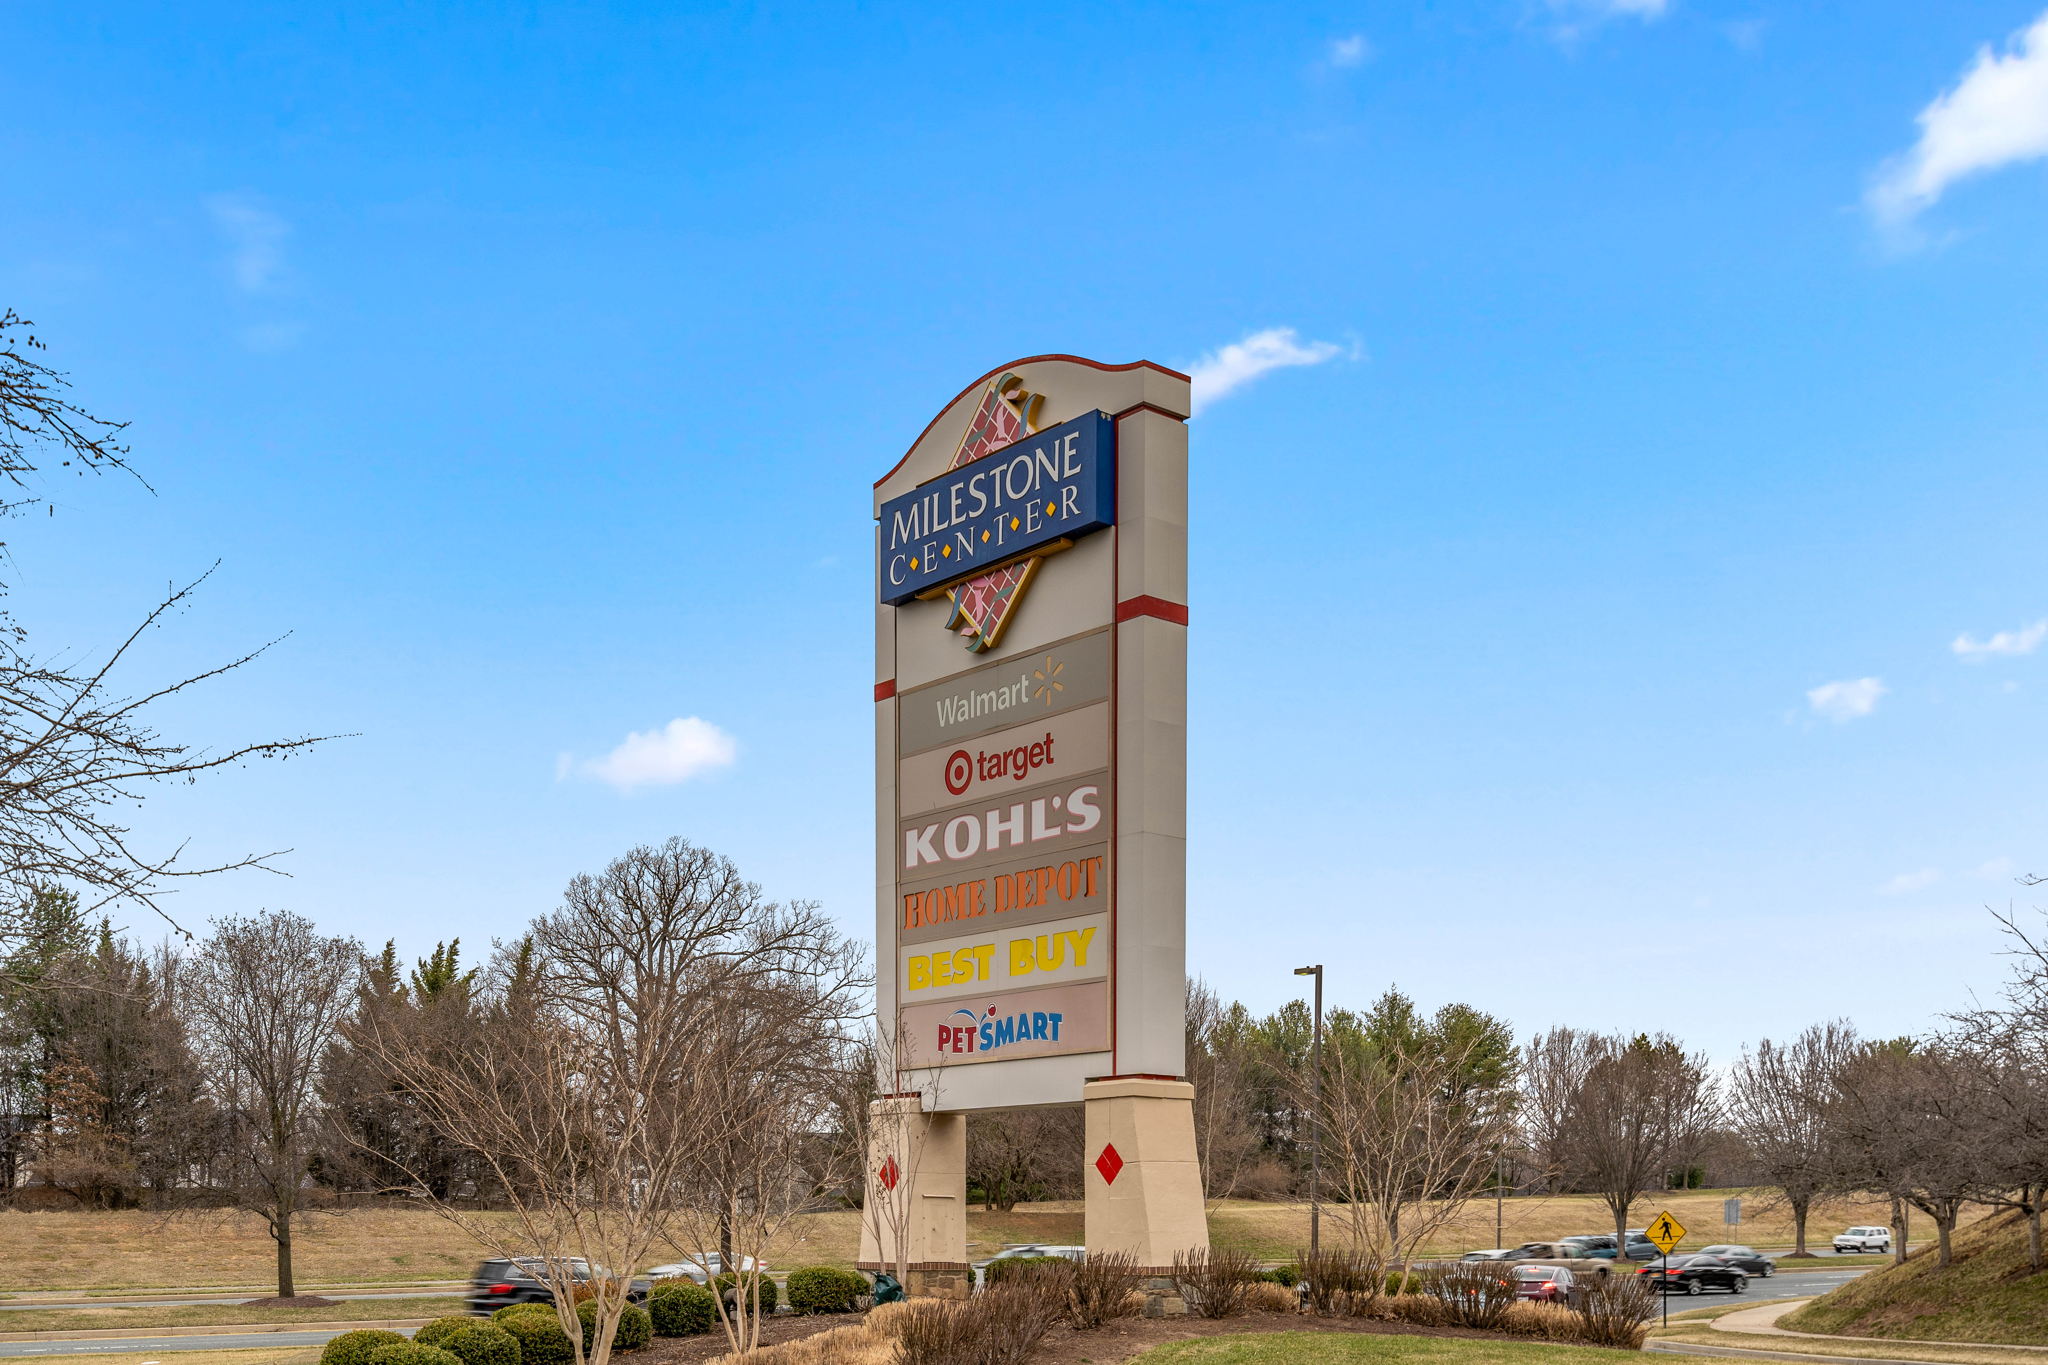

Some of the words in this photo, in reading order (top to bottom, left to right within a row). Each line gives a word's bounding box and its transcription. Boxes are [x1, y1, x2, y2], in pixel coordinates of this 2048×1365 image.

[889, 432, 1081, 550] MILESTONE
[936, 674, 1029, 727] Walmart
[977, 733, 1054, 781] target
[905, 785, 1101, 868] KOHL'S
[904, 879, 987, 930] HOME
[994, 856, 1103, 913] DEPOT
[908, 944, 996, 991] BEST
[1009, 926, 1097, 976] BUY
